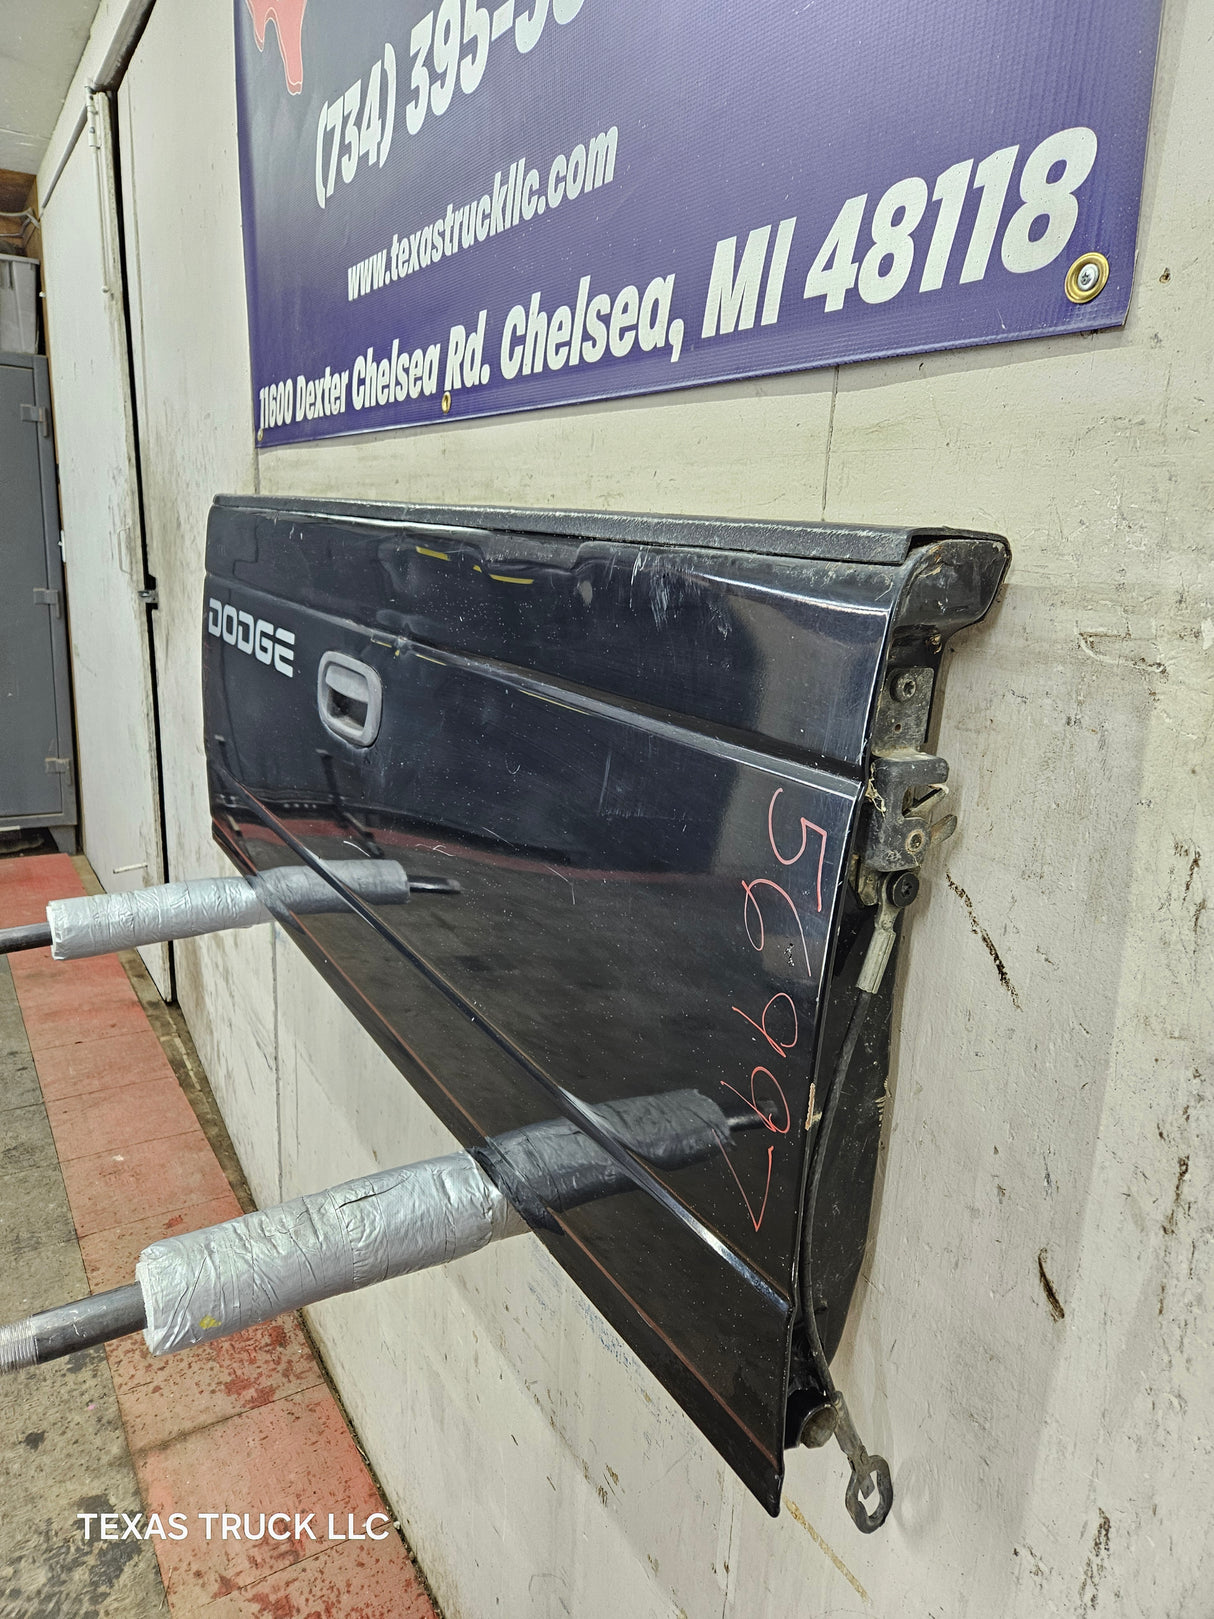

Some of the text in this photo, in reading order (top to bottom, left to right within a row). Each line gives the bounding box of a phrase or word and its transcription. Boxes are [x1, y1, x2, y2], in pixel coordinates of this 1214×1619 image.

[315, 0, 586, 209] (734) 395-
[259, 126, 1099, 429] 11600 Dexter Chelsea Rd. Chelsea, MI 48118
[347, 126, 619, 301] www.texastruckllc.com
[207, 597, 296, 679] DODGE
